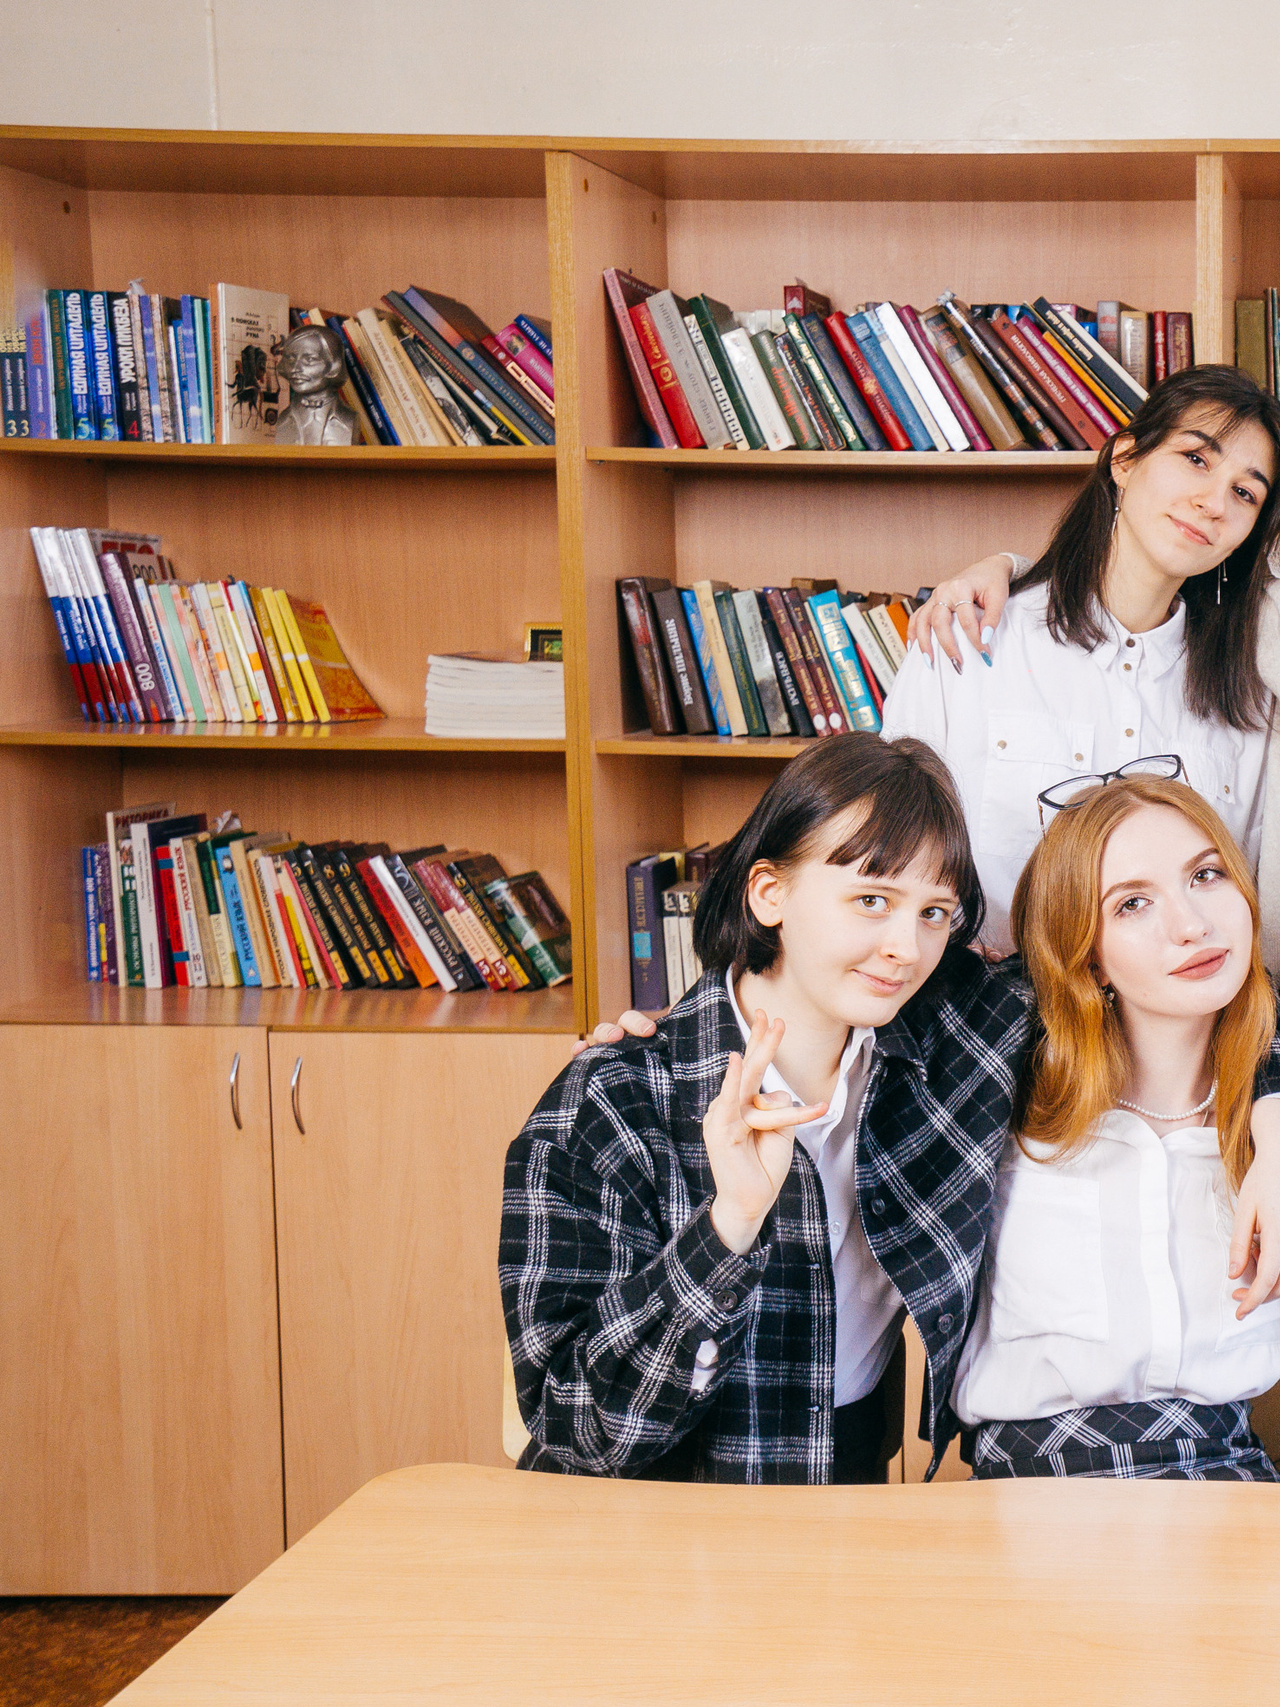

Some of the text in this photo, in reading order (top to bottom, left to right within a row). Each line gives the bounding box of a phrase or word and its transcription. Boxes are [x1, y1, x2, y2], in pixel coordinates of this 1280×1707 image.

[66, 293, 88, 395] ЕДИНАЯ ЦИТАДЕЛЬ
[90, 294, 113, 396] ЕДИНАЯ ЦИТАДЕЛЬ
[113, 298, 136, 384] УРОКИ ЛИКБЕЗА
[1009, 333, 1043, 372] МИФОЛОГИЯ
[1038, 369, 1067, 403] ГРЕЧЕСКАЯ
[6, 419, 17, 437] 3
[20, 419, 30, 437] 3
[78, 418, 90, 439] 5
[102, 418, 114, 440] 5
[128, 420, 140, 438] 4
[665, 618, 694, 706] Борис ПИЛЬНЯК
[771, 649, 803, 706] ВАСИЛЬ БЫКОВ
[174, 846, 192, 911] РУССКИЙ ЯЗЫК
[323, 864, 335, 880] 8
[339, 862, 350, 878] 9
[411, 896, 435, 926] ЯЗЫК
[427, 925, 458, 968] РУССКИЙ
[478, 960, 490, 976] 5
[494, 960, 506, 976] 5
